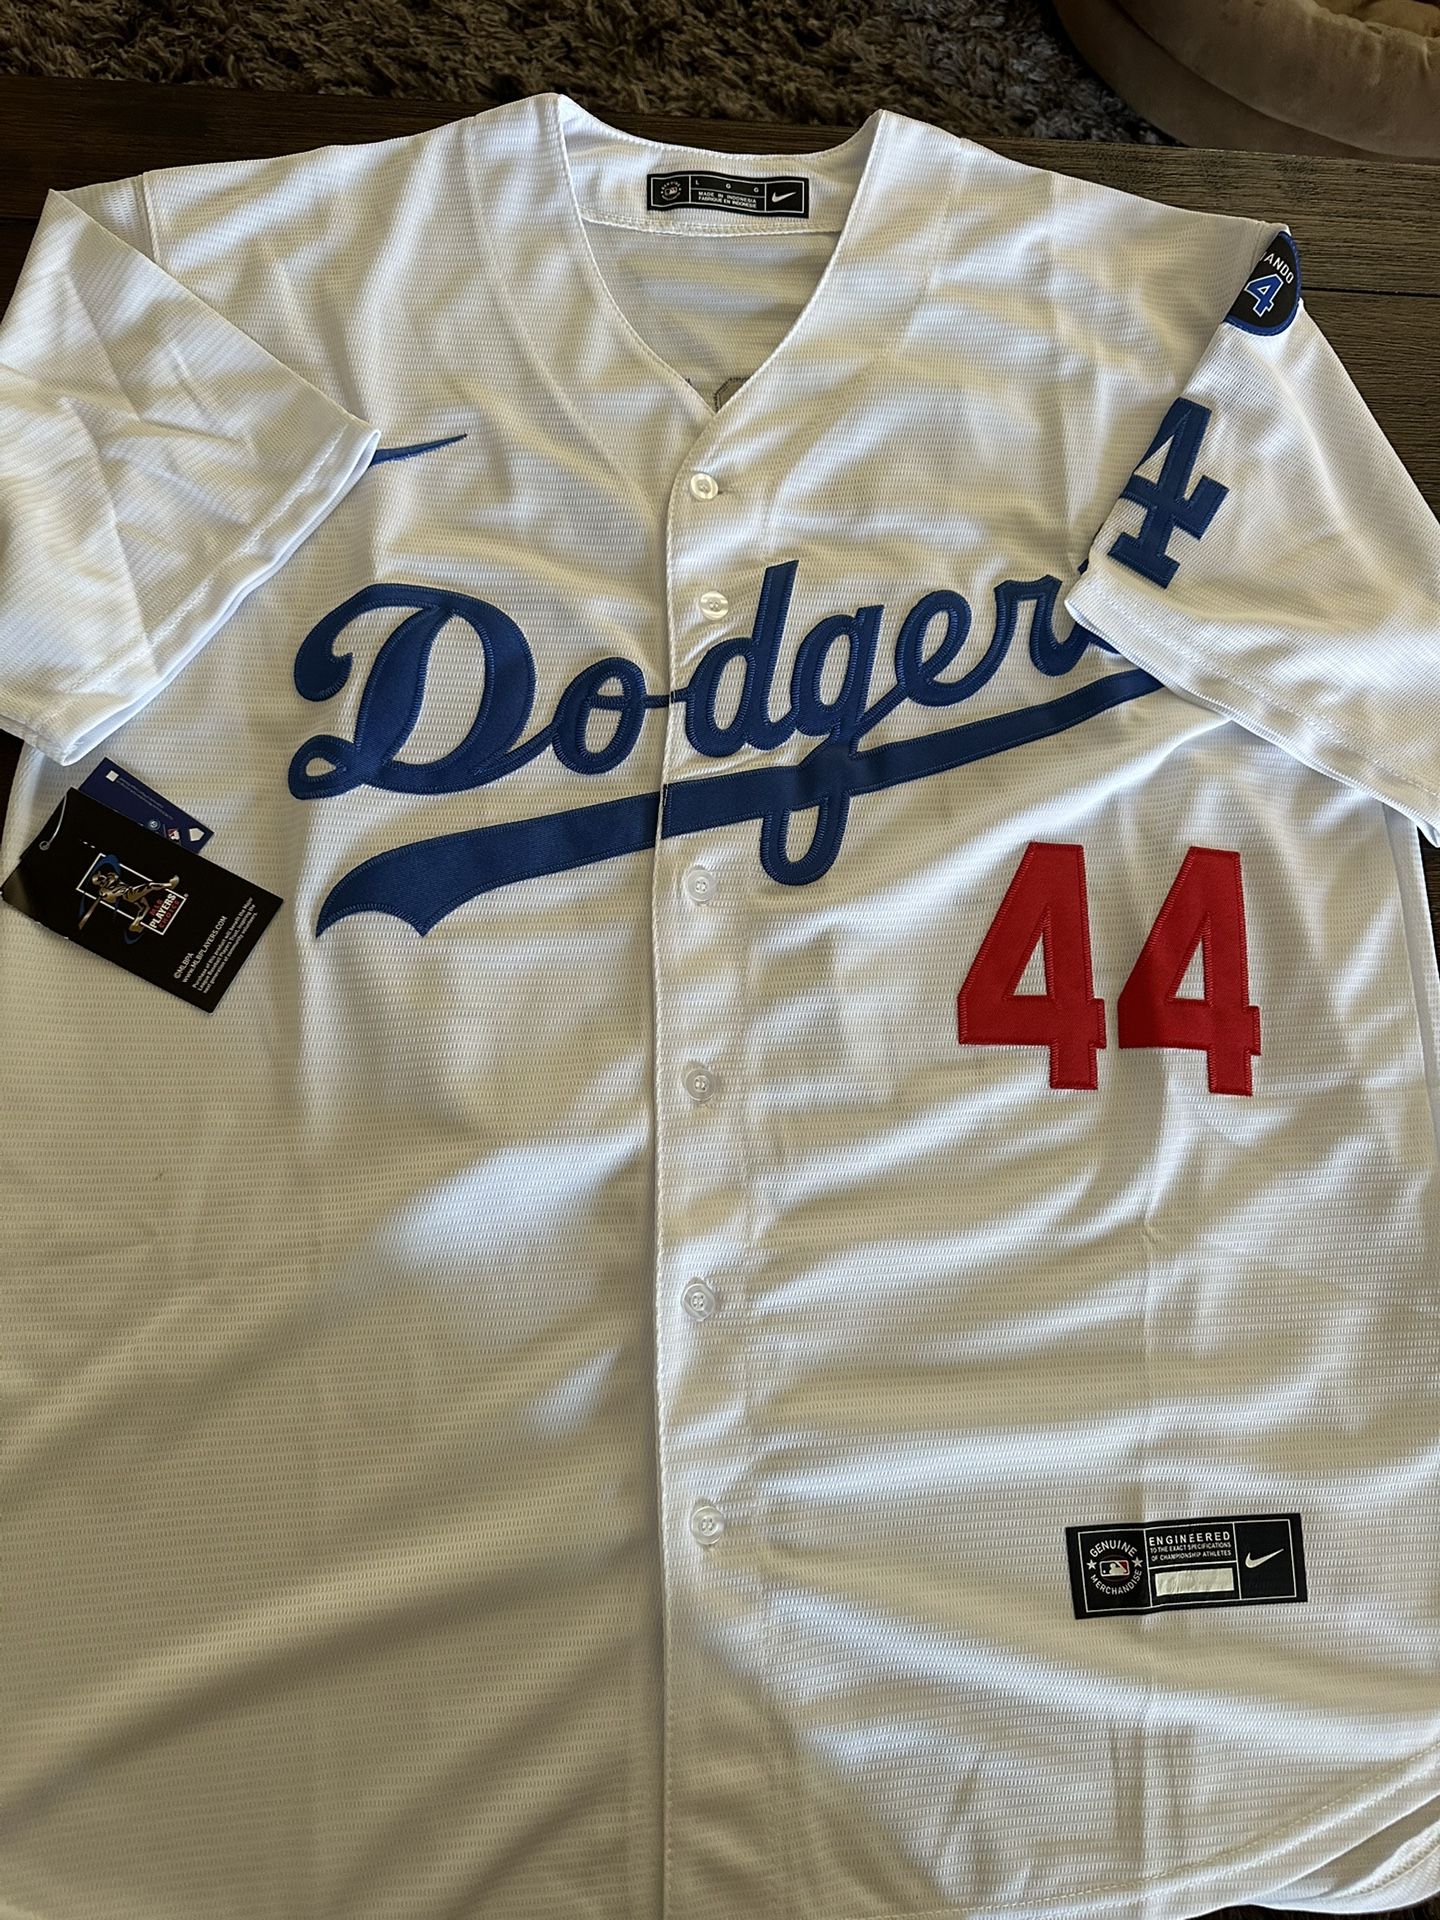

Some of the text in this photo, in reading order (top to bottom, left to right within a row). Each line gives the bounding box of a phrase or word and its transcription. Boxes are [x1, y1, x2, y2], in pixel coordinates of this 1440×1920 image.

[726, 195, 757, 203] INDONESIA
[1260, 252, 1295, 284] ANDO
[1244, 274, 1284, 318] 4
[288, 559, 1121, 886] Dodger
[149, 893, 175, 927] PLAYERS
[957, 841, 1261, 1097] 44
[1089, 1540, 1138, 1558] GENUINE
[1149, 1531, 1230, 1547] ENGINEERED
[1169, 1544, 1187, 1552] EXACT
[1187, 1542, 1232, 1551] SPECIFICATIONS
[1159, 1551, 1202, 1561] CHAMPIONSHIP
[1202, 1549, 1232, 1557] ATHLETES
[1090, 1569, 1142, 1595] MERCHANDISE
